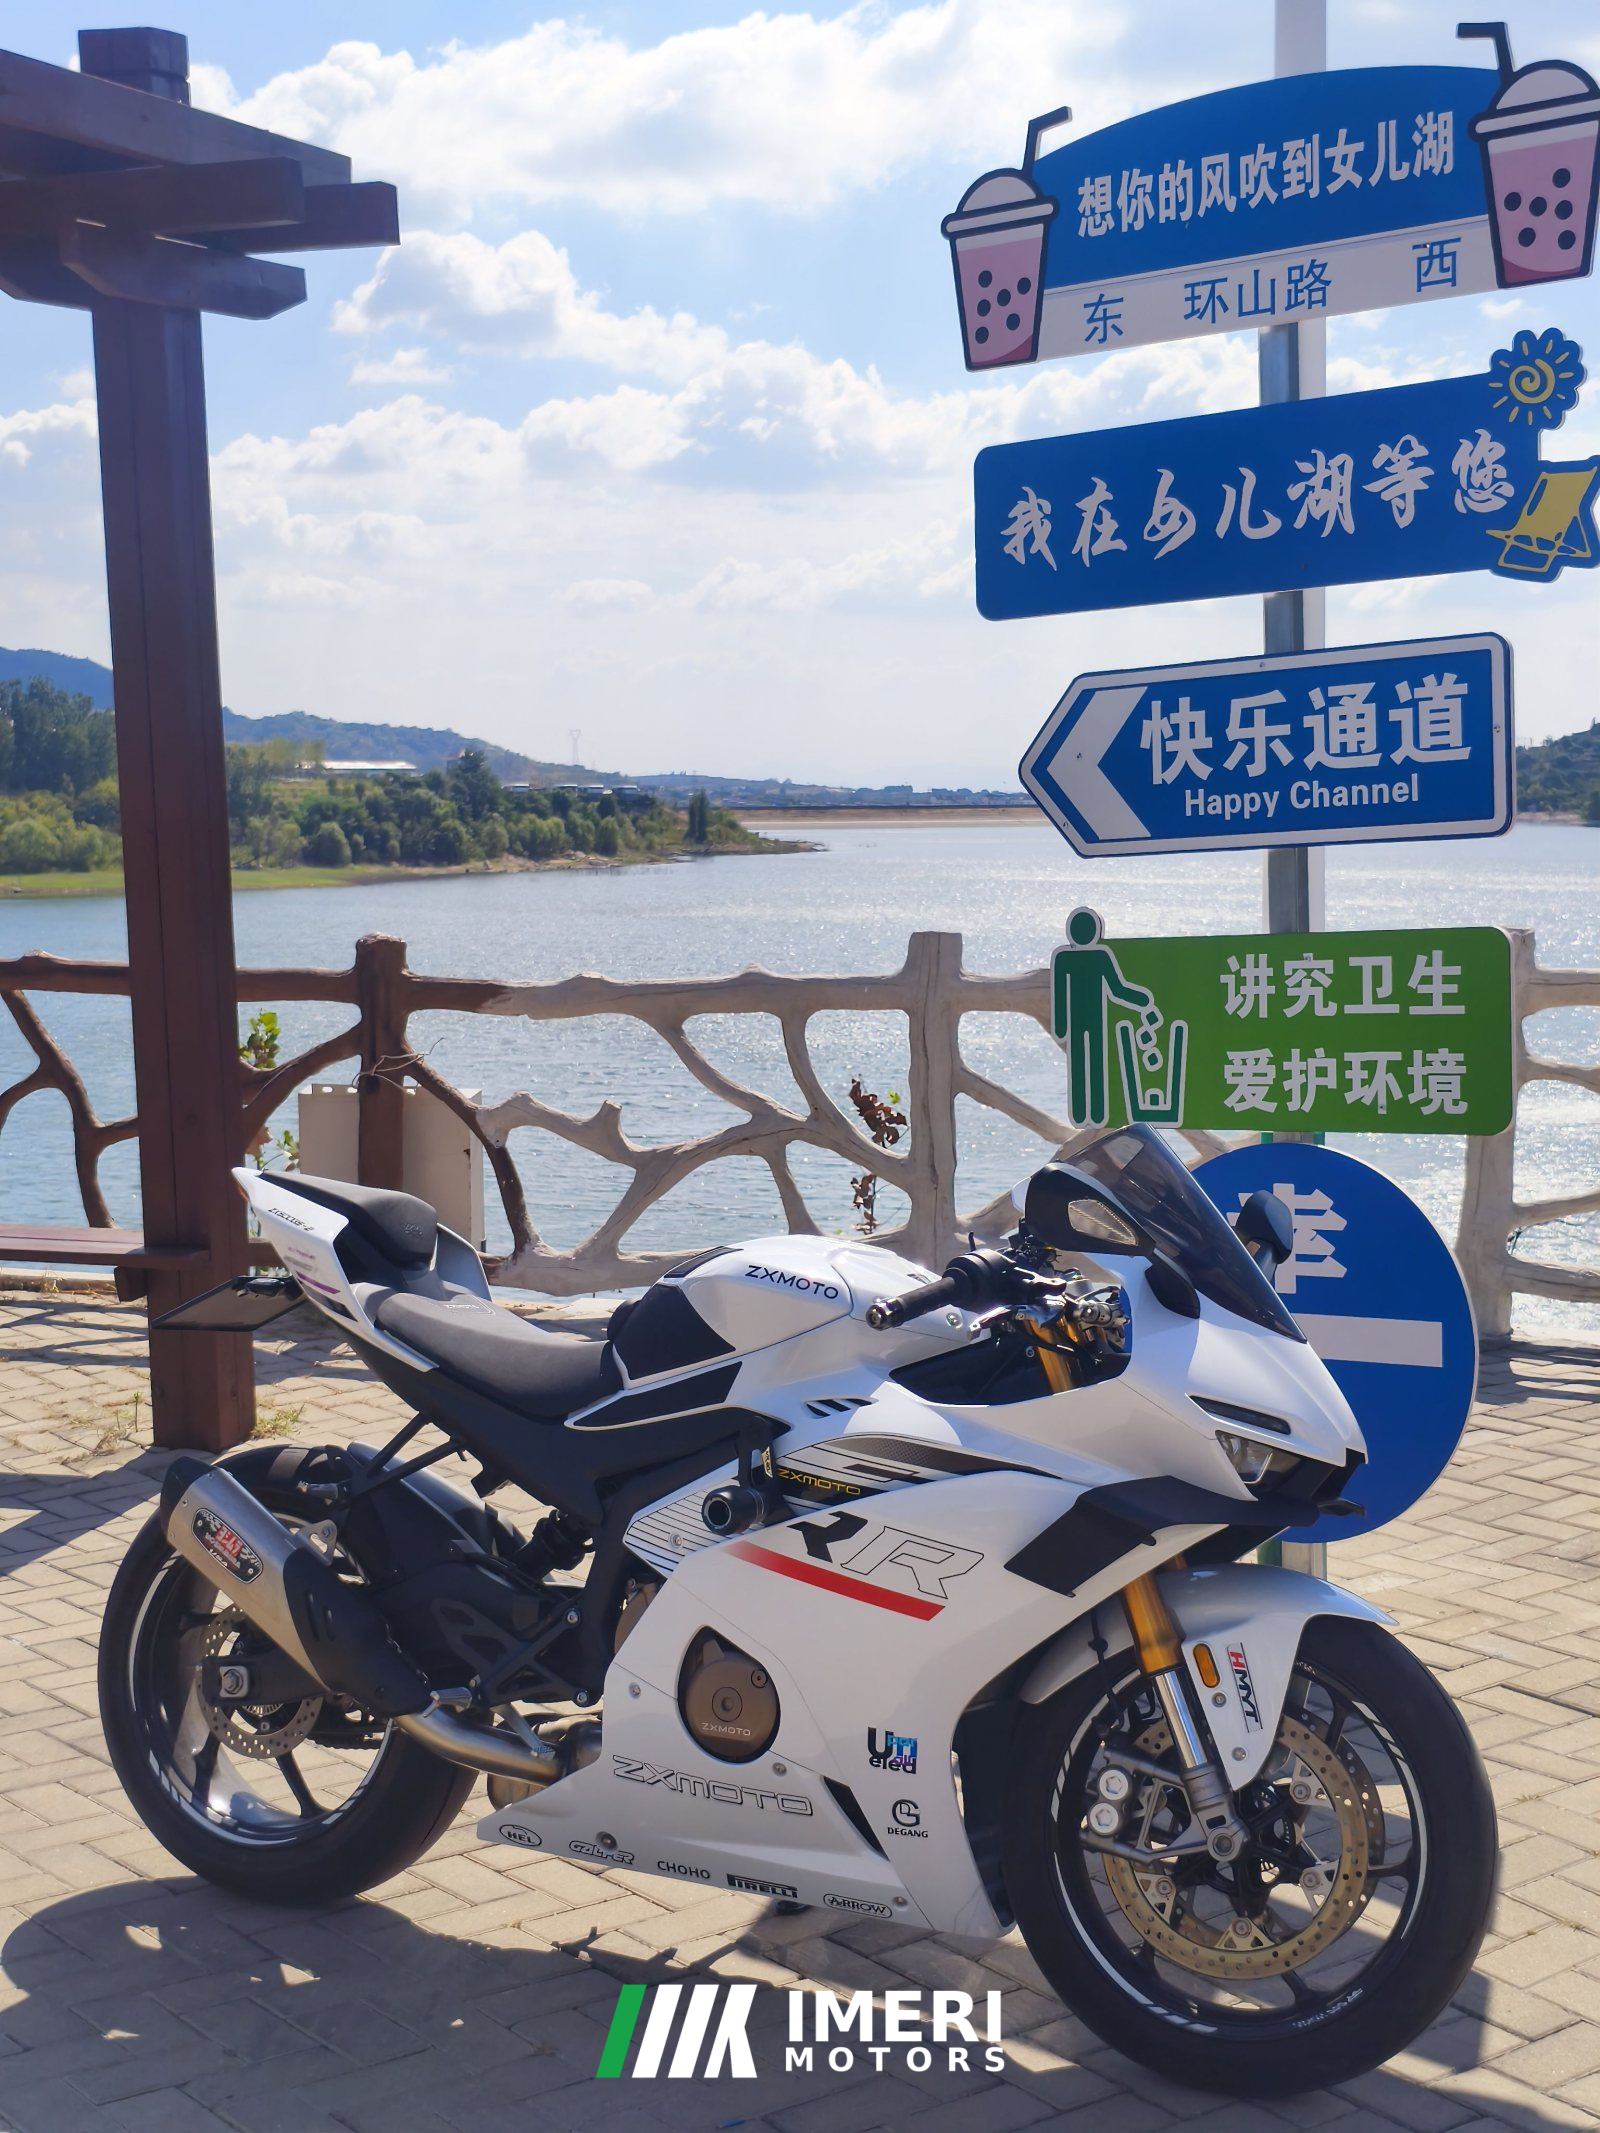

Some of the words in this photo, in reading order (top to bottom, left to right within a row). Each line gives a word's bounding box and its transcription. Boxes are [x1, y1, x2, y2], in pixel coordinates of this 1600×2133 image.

[1077, 111, 1455, 238] 想你的风吹到女儿湖
[1083, 293, 1125, 344] 东
[1183, 257, 1333, 324] 环山路
[1411, 237, 1463, 292] 西
[1139, 672, 1473, 786] 快乐通道
[1184, 785, 1279, 820] Happy
[1289, 773, 1419, 809] Channel
[1219, 949, 1467, 1019] 讲究卫生
[1222, 1047, 1469, 1115] 爱护环境
[745, 1264, 840, 1300] ZXMOTO
[777, 1468, 861, 1496] ZXMOTO
[701, 1722, 751, 1736] ZXMOTO
[612, 1755, 813, 1817] ZXMOTO
[887, 1826, 928, 1838] DEGANG
[657, 1860, 711, 1879] CHOHO
[726, 1873, 798, 1898] PIRELLI
[827, 1896, 887, 1915] ARROW
